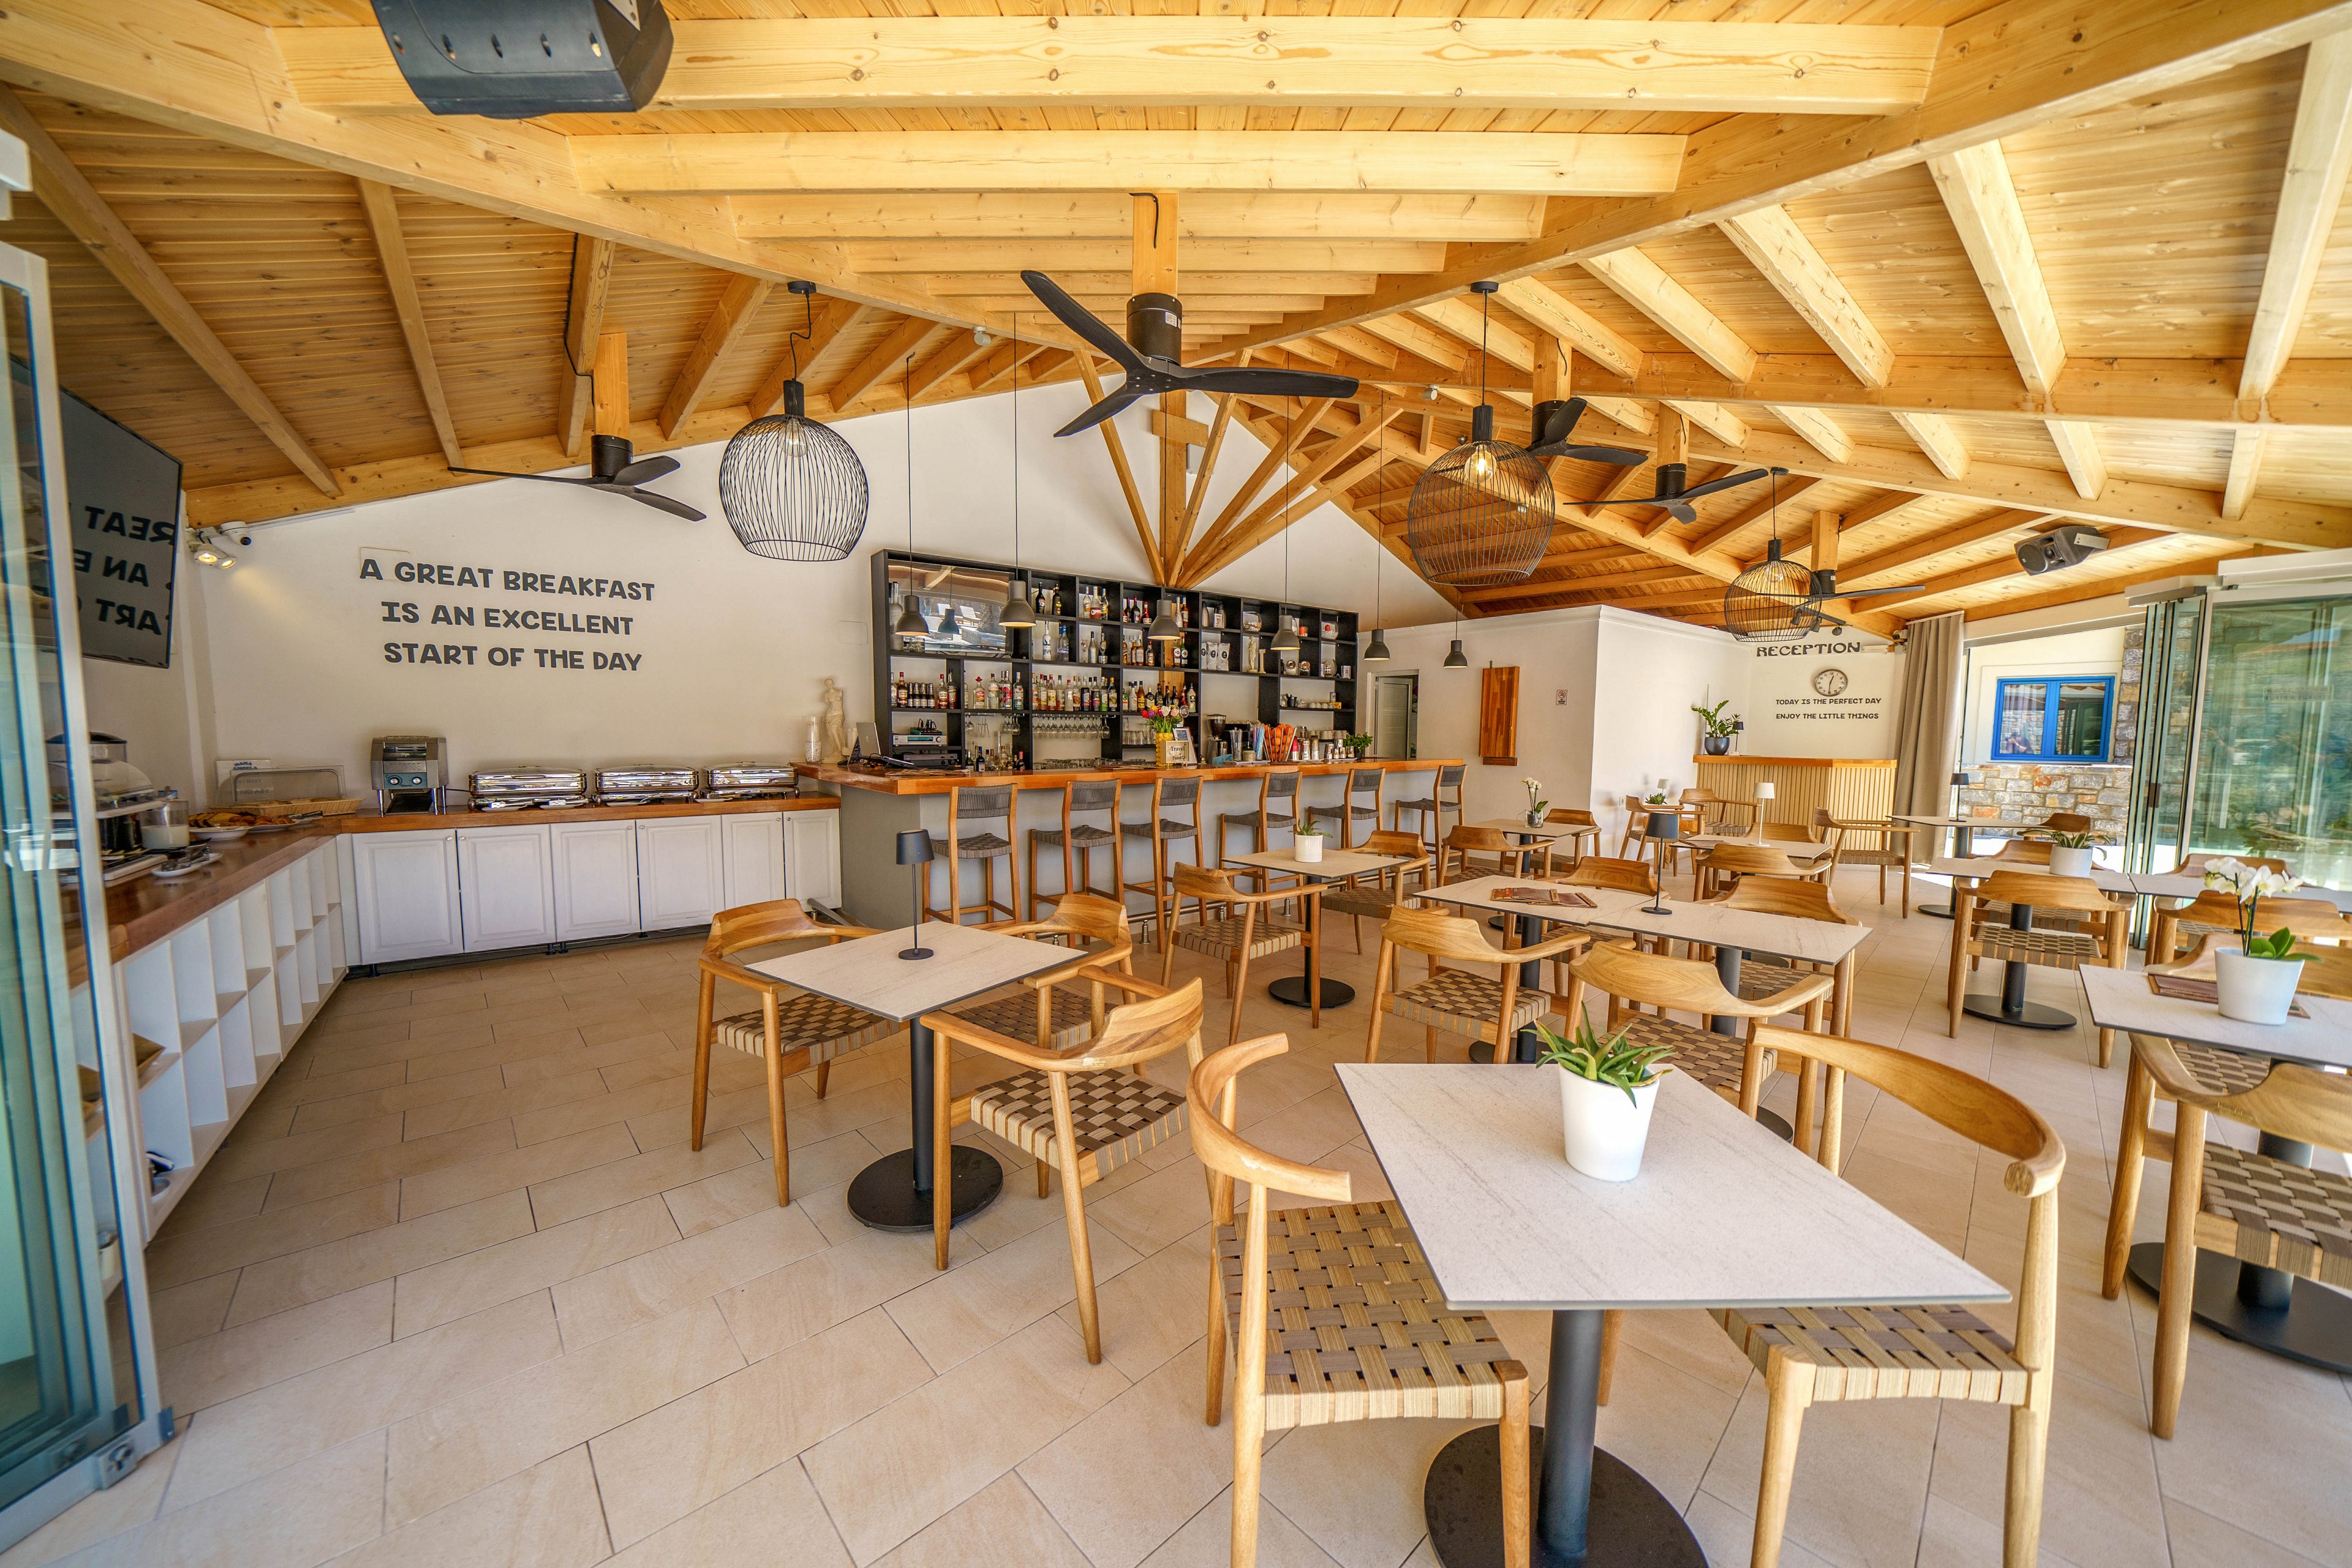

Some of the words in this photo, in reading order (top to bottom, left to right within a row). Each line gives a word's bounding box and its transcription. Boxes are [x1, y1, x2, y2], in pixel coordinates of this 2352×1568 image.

[360, 559, 383, 581] A
[394, 562, 494, 588] GREAT
[503, 570, 655, 601] BREAKFAST
[381, 601, 420, 624] IS
[431, 605, 475, 626] AN
[484, 608, 633, 635] EXCELLENT
[383, 642, 478, 665] START
[488, 647, 525, 667] OF
[533, 649, 584, 669] THE
[593, 651, 643, 671] DAY
[1756, 642, 1860, 657] RECEPTION
